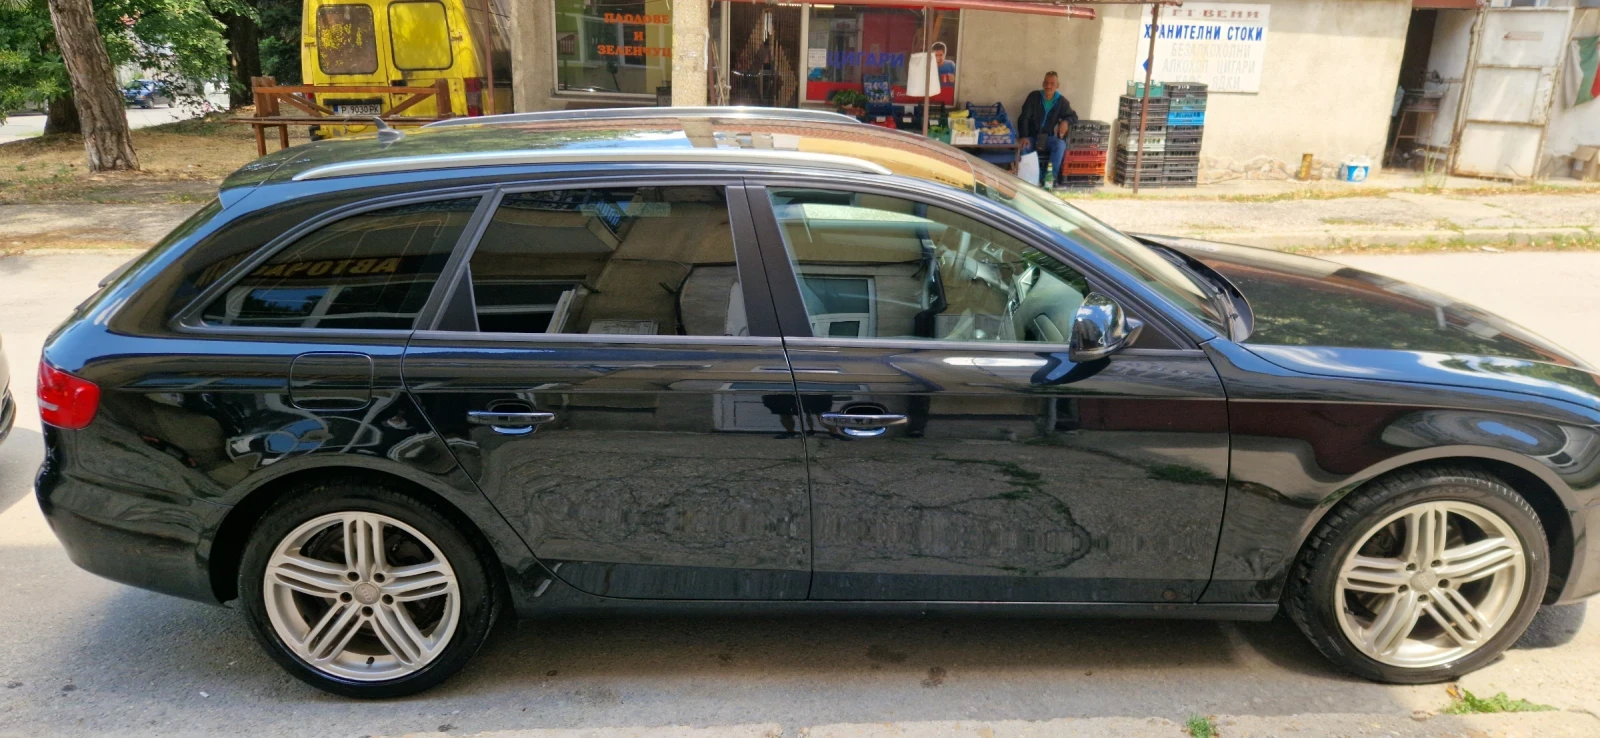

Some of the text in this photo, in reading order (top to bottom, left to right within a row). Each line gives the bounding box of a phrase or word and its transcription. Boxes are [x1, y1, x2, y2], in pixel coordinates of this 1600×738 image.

[604, 12, 670, 25] ПЛОДОВЕ
[633, 31, 644, 41] И
[1227, 26, 1263, 41] СТОКИ
[597, 45, 672, 58] ЗЕЛЕНЧУЦ
[1171, 42, 1251, 58] БЕЗАЛКОХОЛНИ
[826, 51, 904, 69] ЦИГАРИ
[1216, 60, 1256, 74] ЦИГАРИ
